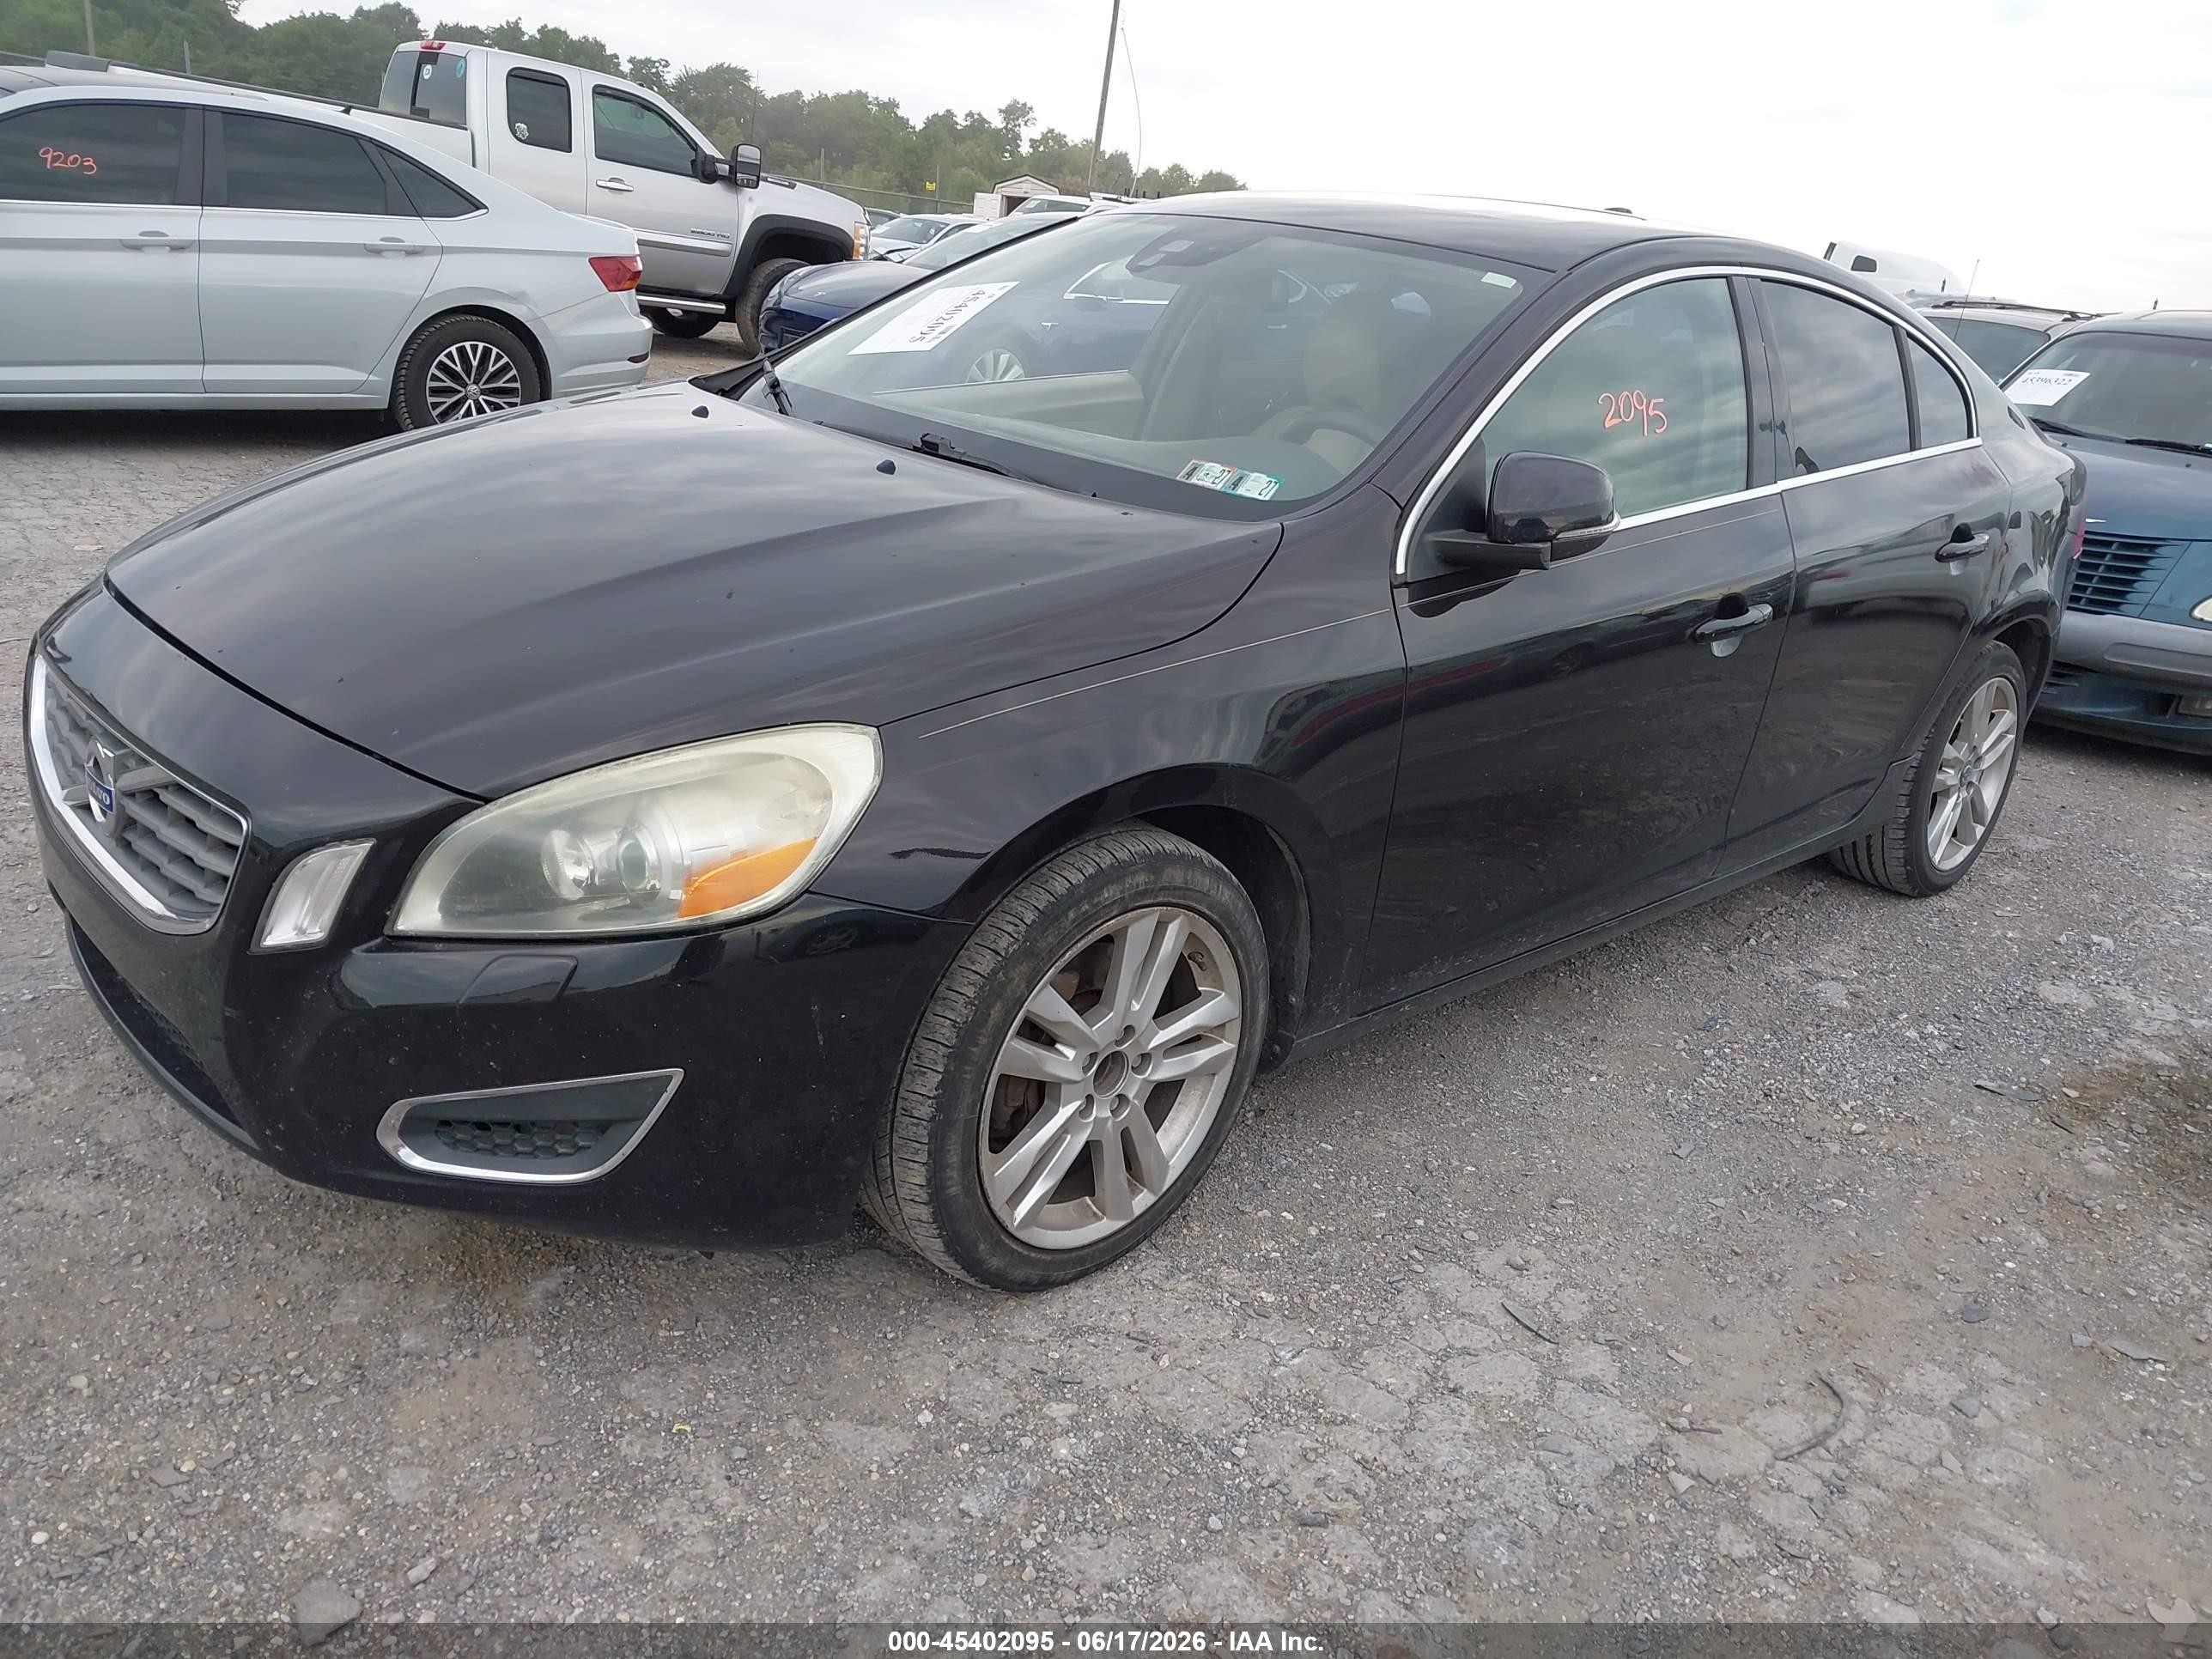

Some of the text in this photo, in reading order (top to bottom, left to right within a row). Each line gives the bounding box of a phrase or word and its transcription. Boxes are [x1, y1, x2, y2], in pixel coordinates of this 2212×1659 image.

[39, 146, 97, 175] 9203
[908, 289, 986, 343] 45402095
[1598, 390, 1668, 437] 2095
[1257, 479, 1279, 499] 27
